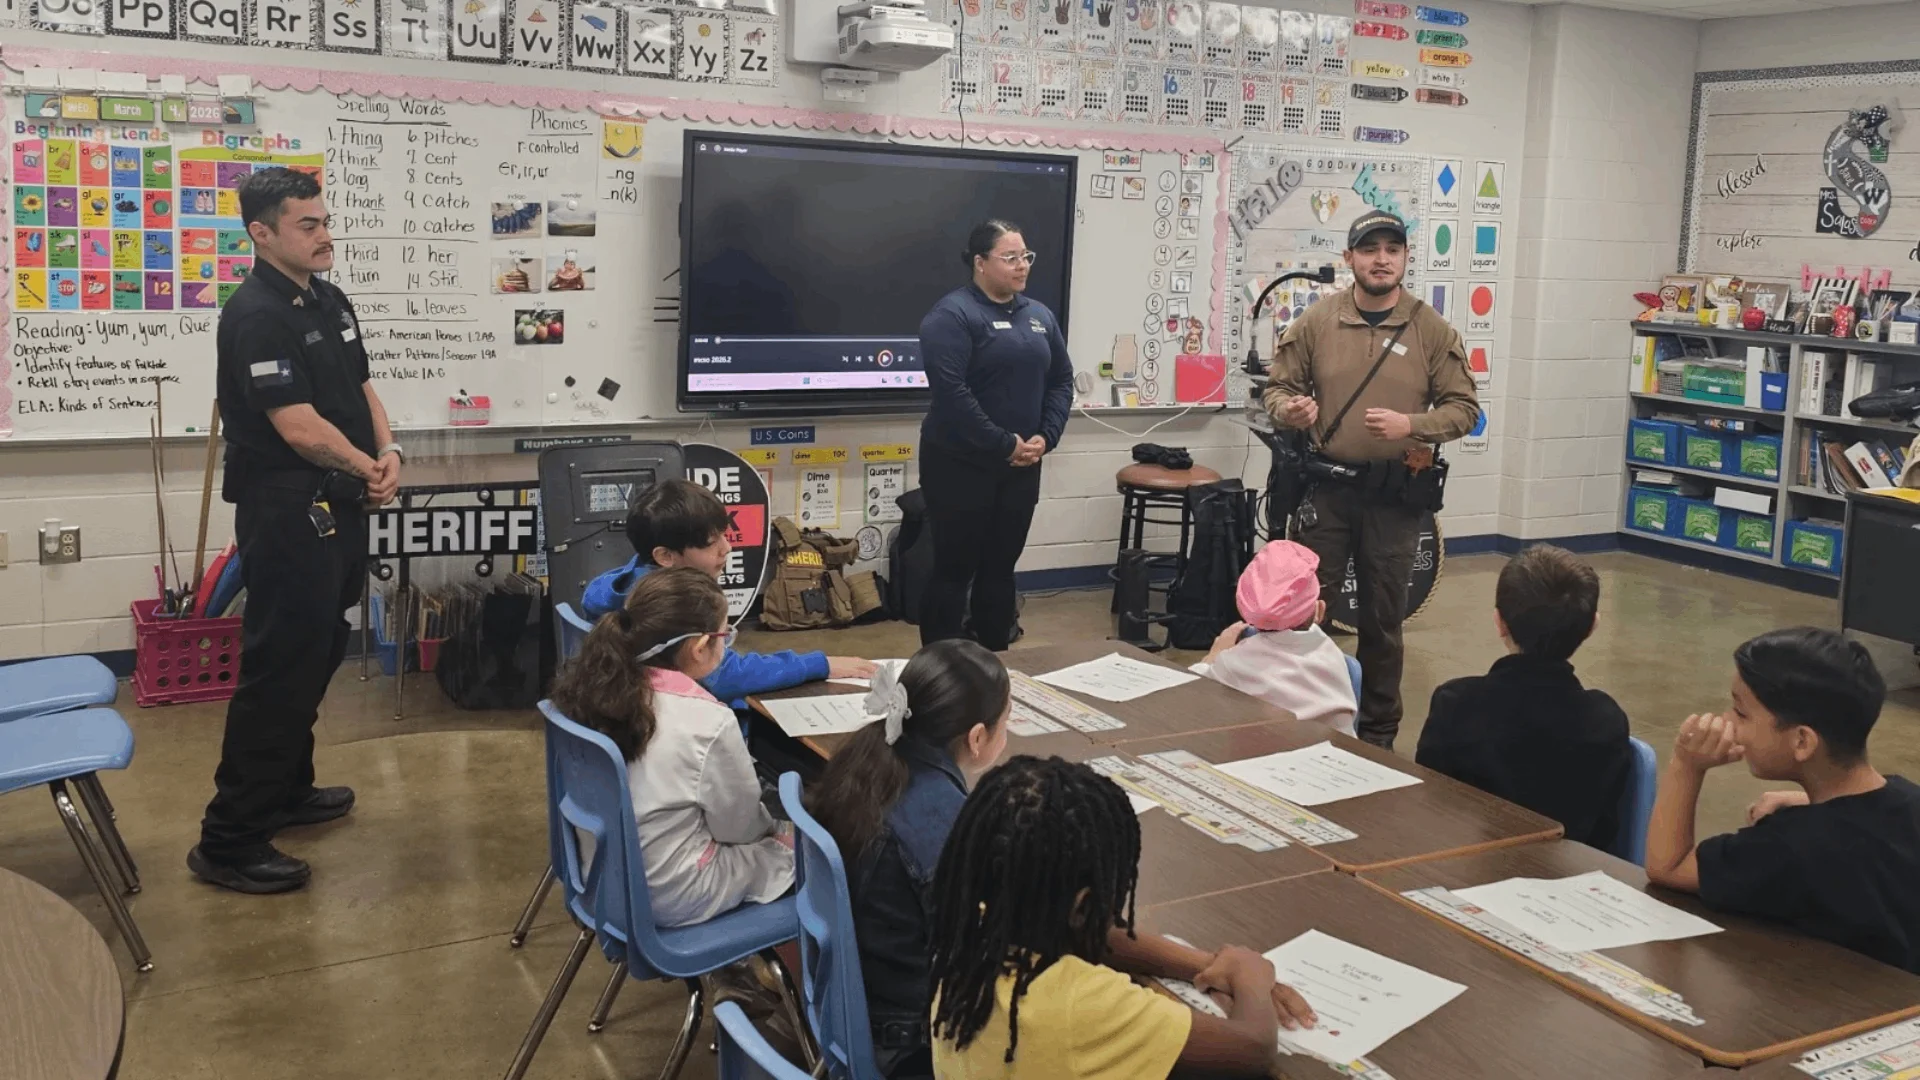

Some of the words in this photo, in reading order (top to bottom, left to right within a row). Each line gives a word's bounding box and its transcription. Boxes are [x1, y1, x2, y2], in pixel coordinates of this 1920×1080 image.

[119, 0, 163, 28] Pp
[190, 1, 238, 35] Qq
[267, 6, 301, 32] Rr
[1126, 0, 1139, 21] 5
[333, 12, 367, 38] Ss
[401, 18, 428, 43] Tt
[457, 23, 496, 49] Uu
[521, 28, 552, 53] Vv
[575, 34, 614, 60] Ww
[633, 40, 665, 64] Xx
[690, 45, 718, 73] Yy
[740, 49, 768, 72] Zz
[1433, 54, 1459, 64] orange
[994, 63, 1010, 84] 12
[1038, 64, 1054, 85] 13
[1166, 68, 1192, 76] SIXTEEN
[1366, 64, 1391, 75] yellow
[1432, 73, 1450, 83] white
[1123, 71, 1139, 92] 15
[1164, 75, 1178, 94] 16
[1203, 78, 1216, 98] 17
[1242, 82, 1255, 101] 18
[1280, 85, 1294, 104] 19
[1368, 88, 1388, 97] black
[114, 103, 141, 115] March
[190, 106, 220, 119] 2026
[337, 94, 390, 121] Spelling
[400, 99, 446, 115] Words
[531, 109, 588, 130] Phonics
[15, 120, 105, 142] Beginning
[342, 125, 383, 152] thing
[424, 129, 479, 147] pitches
[1368, 131, 1393, 141] purple
[202, 129, 301, 152] Digraphs
[518, 139, 579, 154] r-controlled
[340, 149, 379, 167] think
[1104, 154, 1139, 166] Supplies
[1352, 162, 1396, 172] VBES
[344, 167, 369, 192] long
[1717, 155, 1766, 199] blessed
[82, 189, 91, 200] gl
[114, 192, 125, 201] gr
[346, 190, 385, 208] thank
[1820, 190, 1836, 200] Mrs.
[1161, 198, 1169, 211] 2
[1476, 201, 1501, 211] triangle
[344, 213, 384, 233] pitch
[1158, 220, 1166, 233] 3
[1716, 229, 1763, 252] explore
[345, 244, 379, 262] third
[428, 244, 451, 263] her
[1160, 246, 1167, 259] 4
[1432, 258, 1450, 267] oval
[1473, 260, 1496, 268] square
[18, 272, 29, 283] sp
[348, 264, 380, 284] turn
[58, 283, 76, 293] STOP
[154, 281, 171, 296] 12
[425, 298, 467, 314] leaves
[16, 316, 92, 344] Reading:
[179, 315, 210, 336] Qué
[389, 329, 432, 341] American
[14, 343, 72, 359] Objective:
[25, 357, 72, 375] Identify
[75, 355, 117, 371] features
[121, 360, 131, 369] of
[390, 367, 419, 380] Value
[28, 376, 58, 389] Retell
[63, 376, 90, 391] story
[92, 375, 125, 386] events
[128, 375, 138, 385] in
[18, 399, 55, 415] ELA:
[59, 396, 87, 413] Kinds
[93, 397, 104, 410] of
[778, 430, 809, 440] Coins
[795, 452, 811, 460] dime
[862, 449, 885, 459] quarter
[686, 467, 741, 493] IDE
[807, 472, 830, 481] Dime
[870, 468, 902, 476] Quarter
[368, 510, 534, 555] HERIFF
[787, 551, 823, 565] SHERI
[717, 574, 744, 584] EYS
